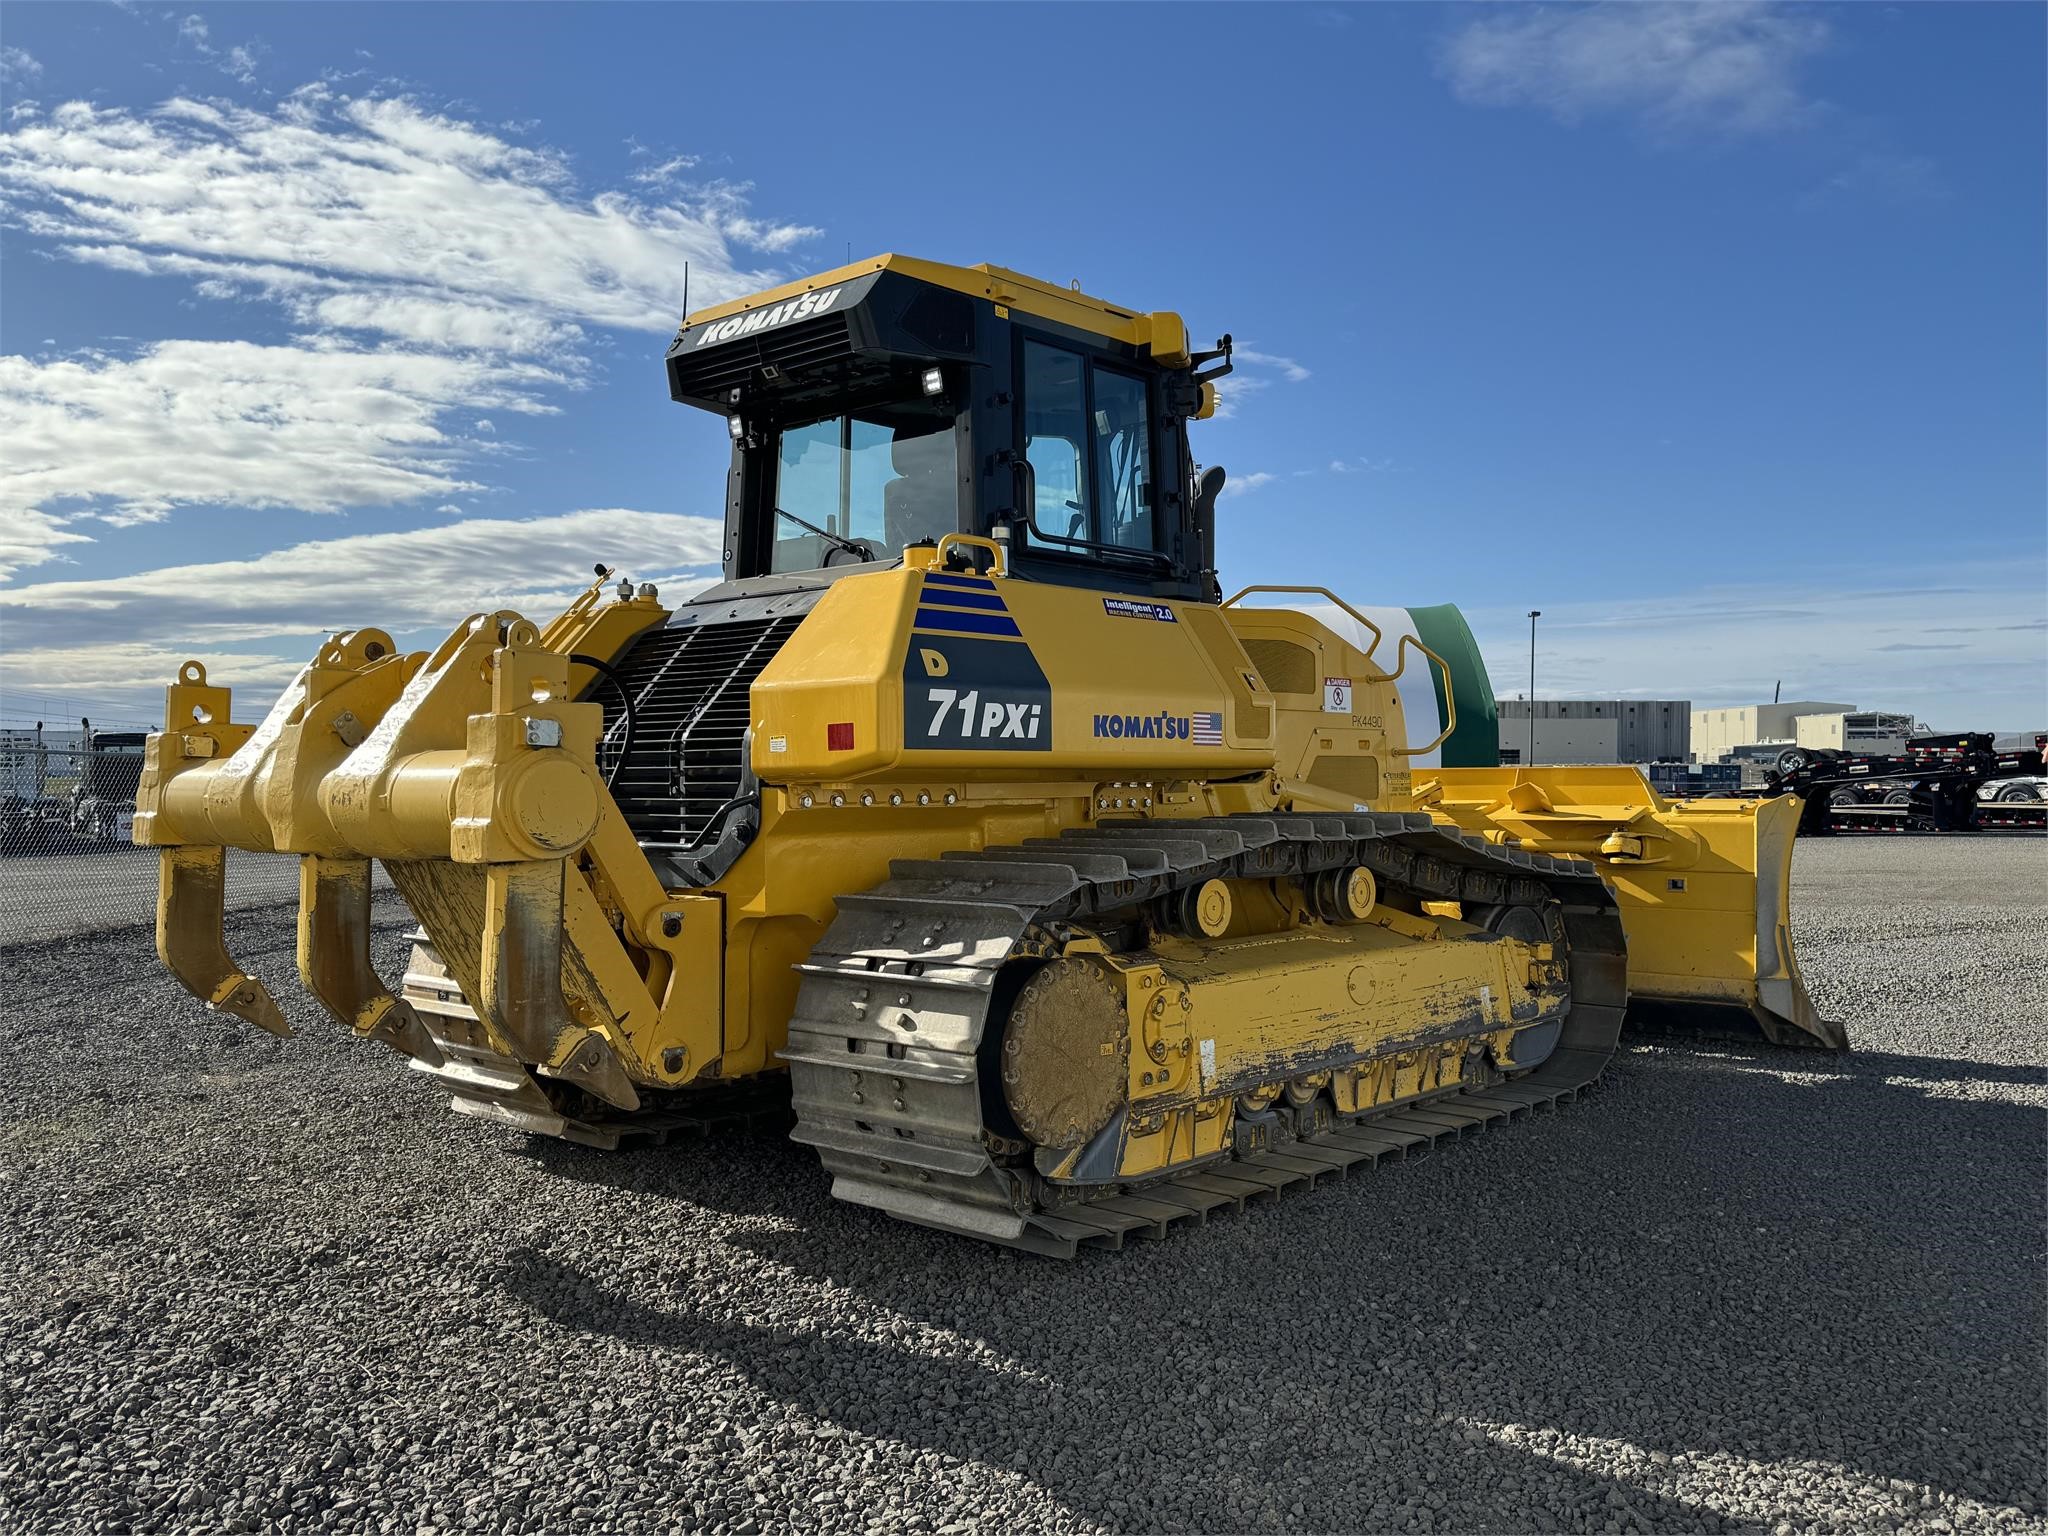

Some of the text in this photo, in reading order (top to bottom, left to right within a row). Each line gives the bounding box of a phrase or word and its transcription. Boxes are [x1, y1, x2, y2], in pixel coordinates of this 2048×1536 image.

[697, 288, 841, 346] KOMATSU
[1105, 600, 1173, 620] Intelligent 2.0
[920, 648, 949, 677] D
[928, 688, 1041, 738] 71PXi
[1093, 711, 1189, 739] KOMATSU
